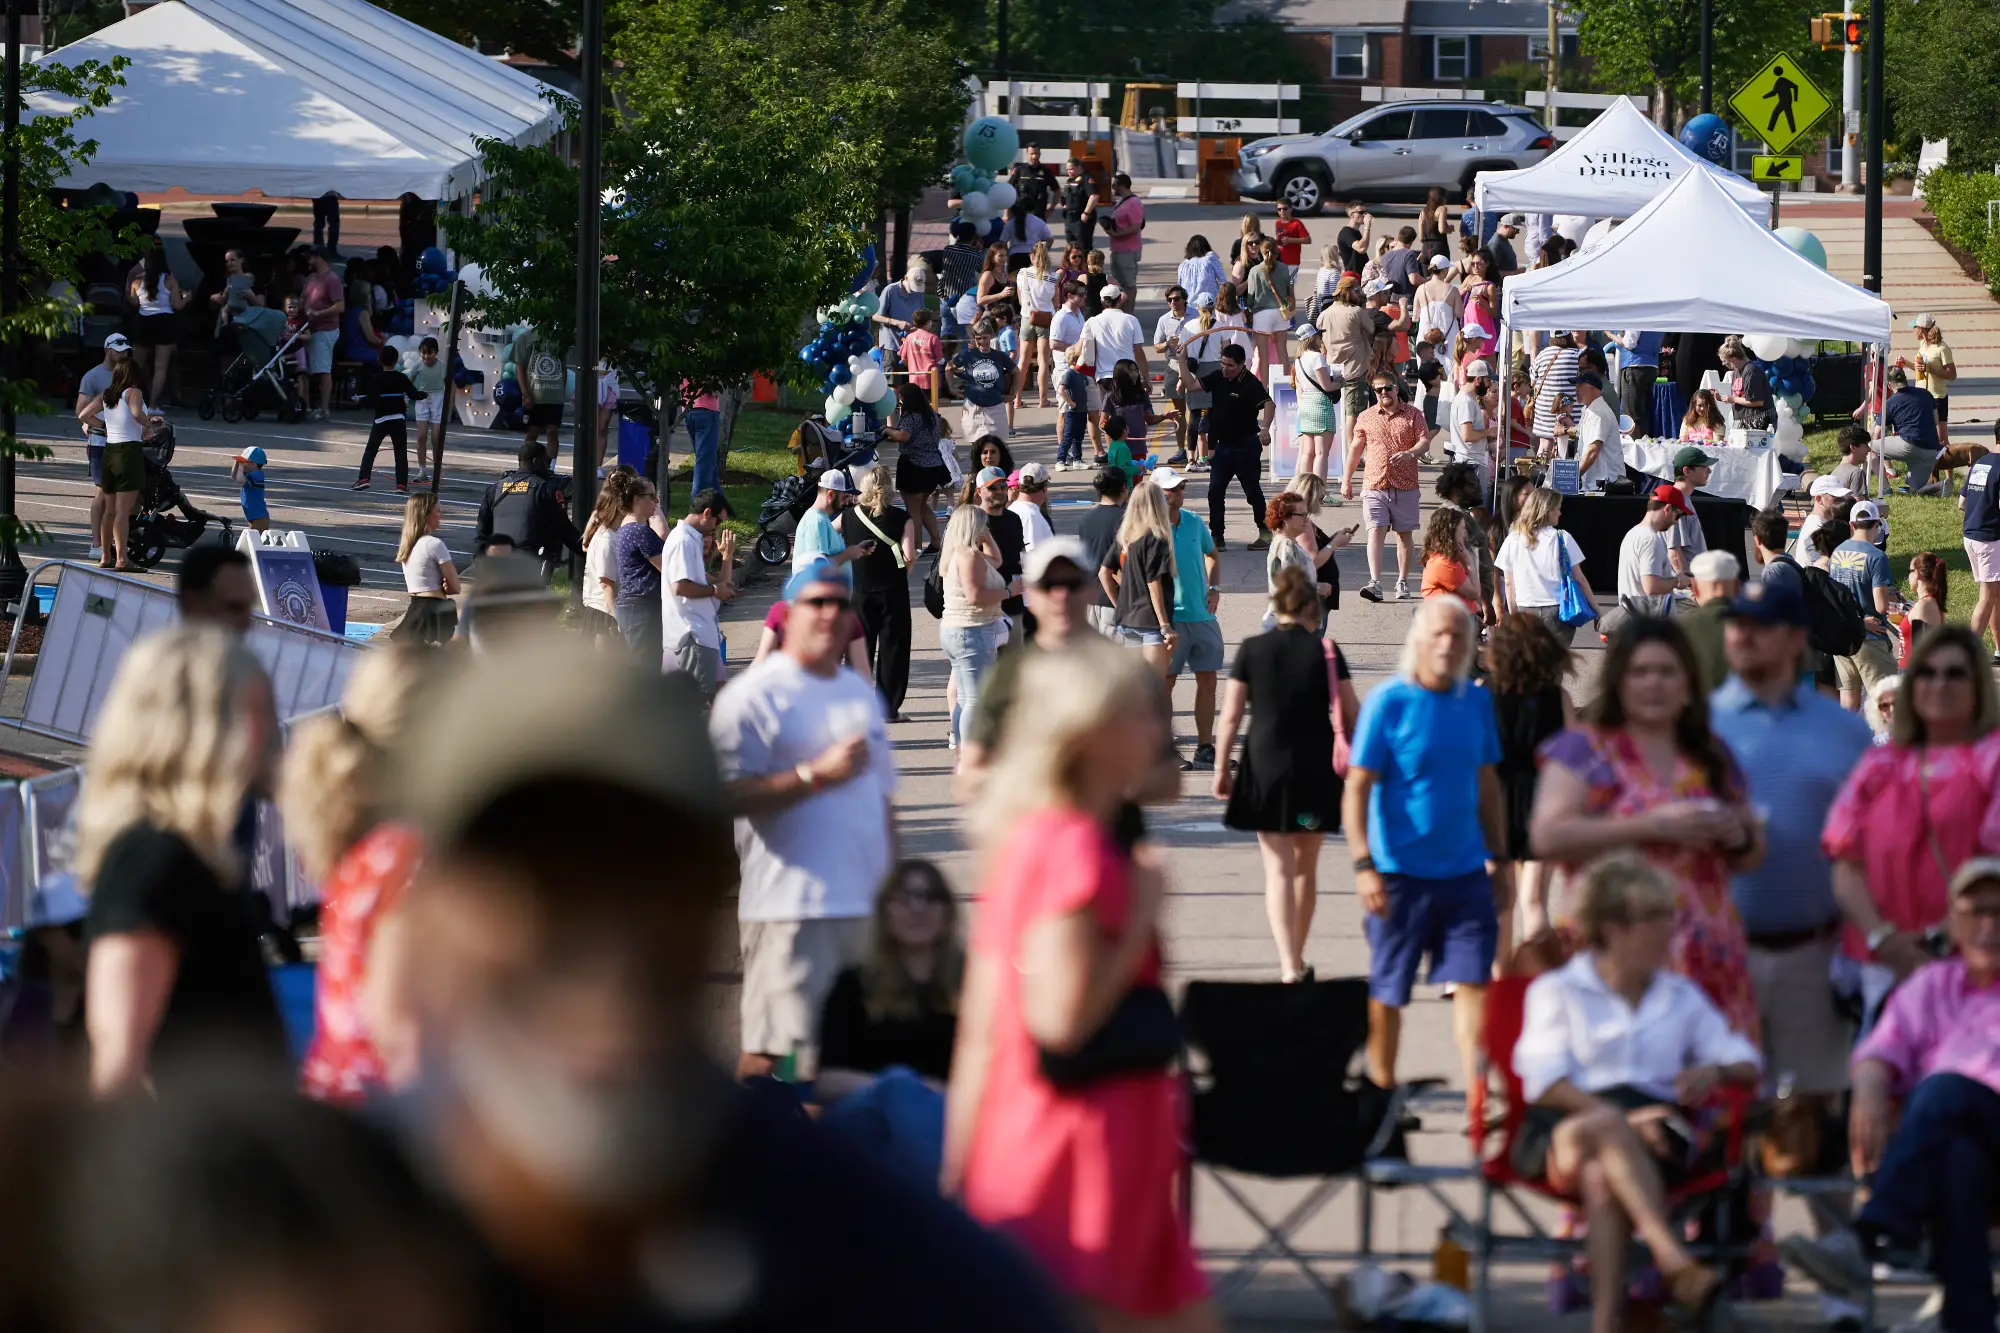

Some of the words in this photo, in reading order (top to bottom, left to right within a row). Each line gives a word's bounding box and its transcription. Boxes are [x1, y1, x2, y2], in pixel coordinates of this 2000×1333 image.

[978, 123, 997, 138] 75
[1713, 131, 1729, 149] 75
[1582, 152, 1669, 168] Village
[1579, 166, 1674, 180] District
